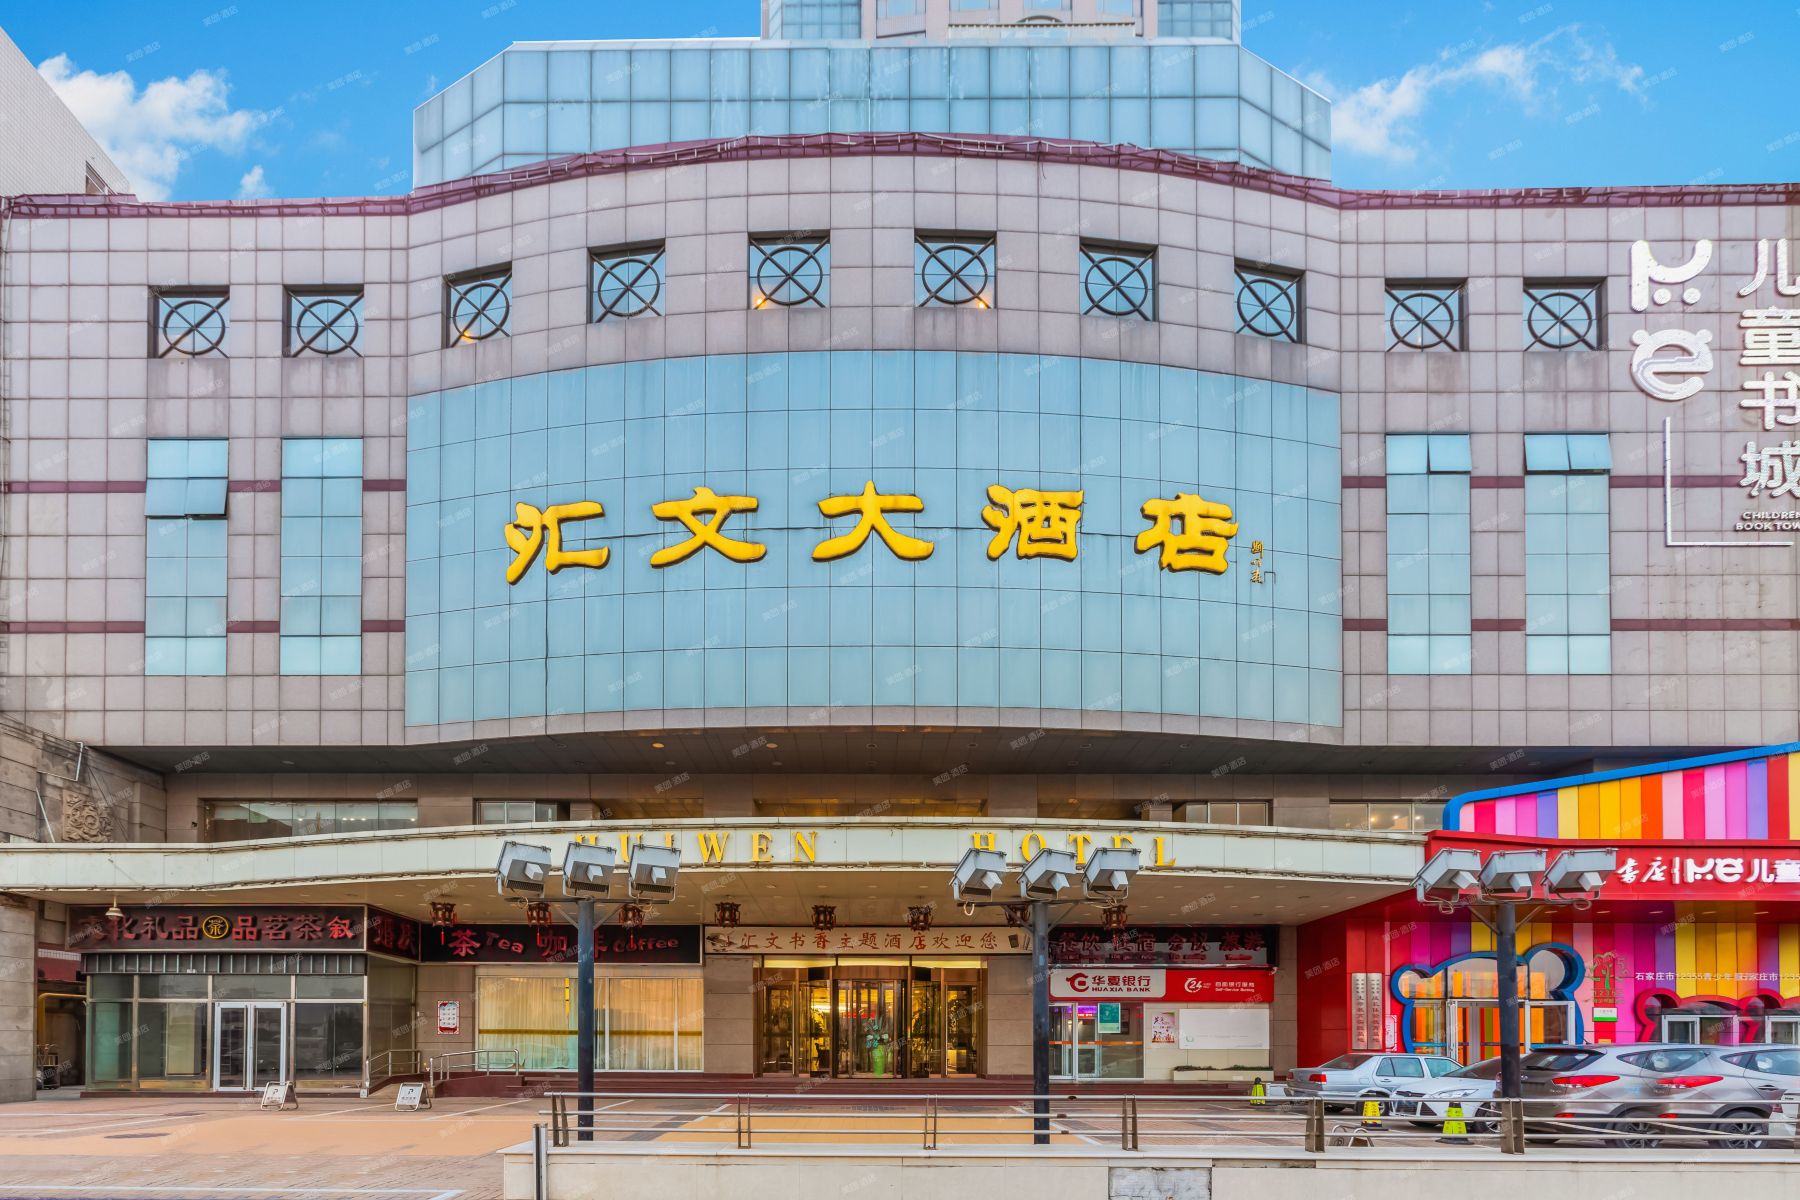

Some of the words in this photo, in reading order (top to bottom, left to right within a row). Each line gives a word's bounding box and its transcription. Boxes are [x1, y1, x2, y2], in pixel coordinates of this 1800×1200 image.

[504, 480, 1240, 584] 汇文大酒店
[1735, 522, 1772, 531] BOOK
[232, 914, 354, 941] 品茗茶叙
[449, 929, 480, 957] 茶
[486, 931, 524, 954] Tea
[741, 931, 998, 951] 汇文书香主题酒店欢迎您
[1091, 975, 1151, 987] 华夏银行
